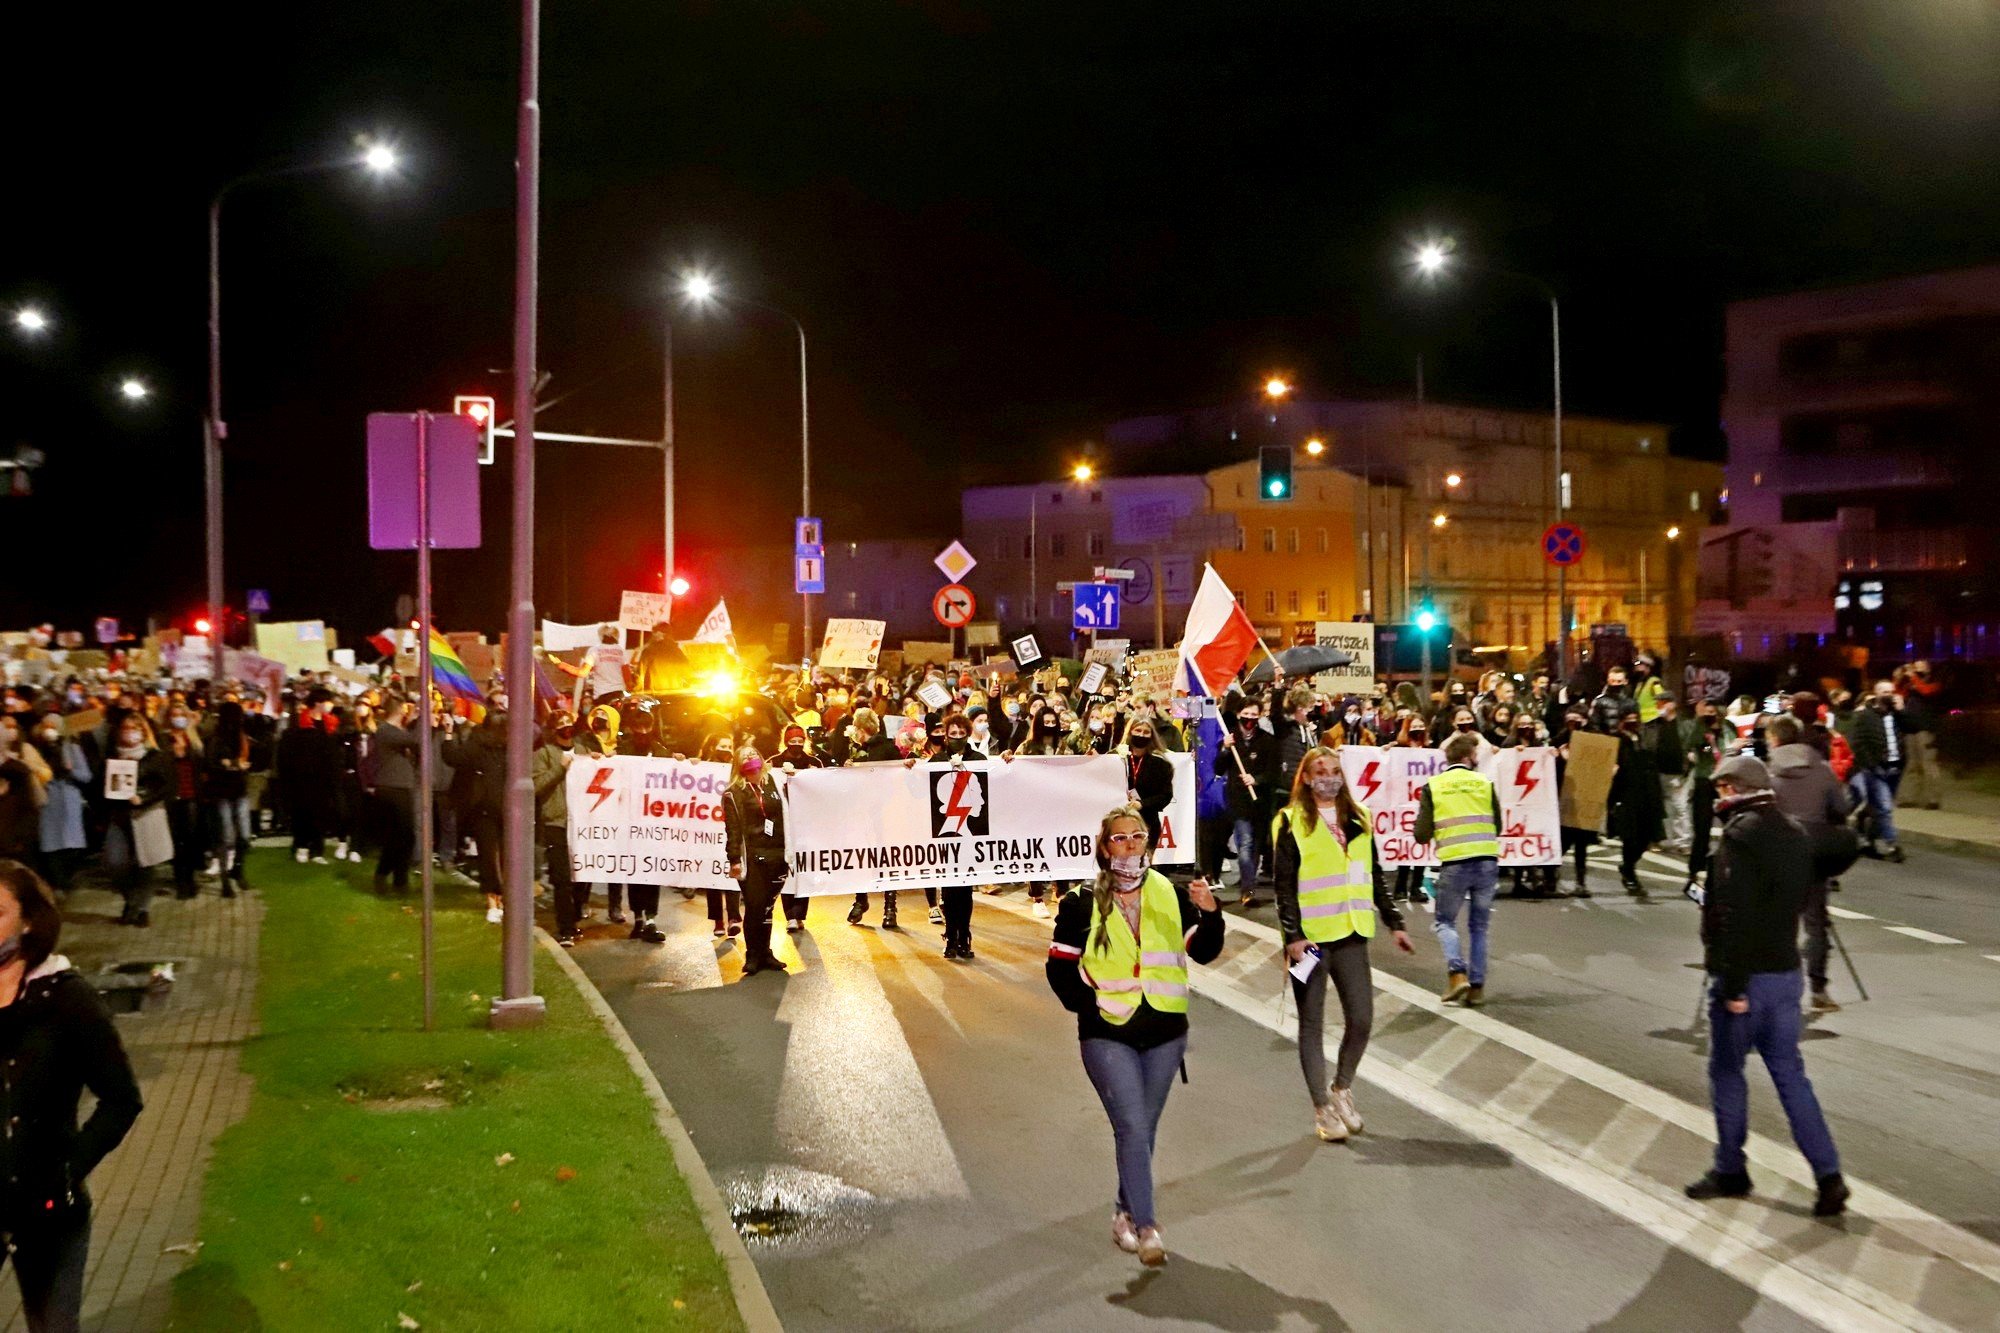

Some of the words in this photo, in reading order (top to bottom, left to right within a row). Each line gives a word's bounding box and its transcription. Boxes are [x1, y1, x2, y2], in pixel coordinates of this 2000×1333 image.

[577, 826, 619, 840] KIEDY
[694, 831, 724, 845] MNIE
[796, 842, 962, 874] MIĘDZYNARODOWY
[974, 838, 1046, 863] STRAJK
[1056, 835, 1092, 858] KOB
[642, 856, 703, 875] SIOSTRY
